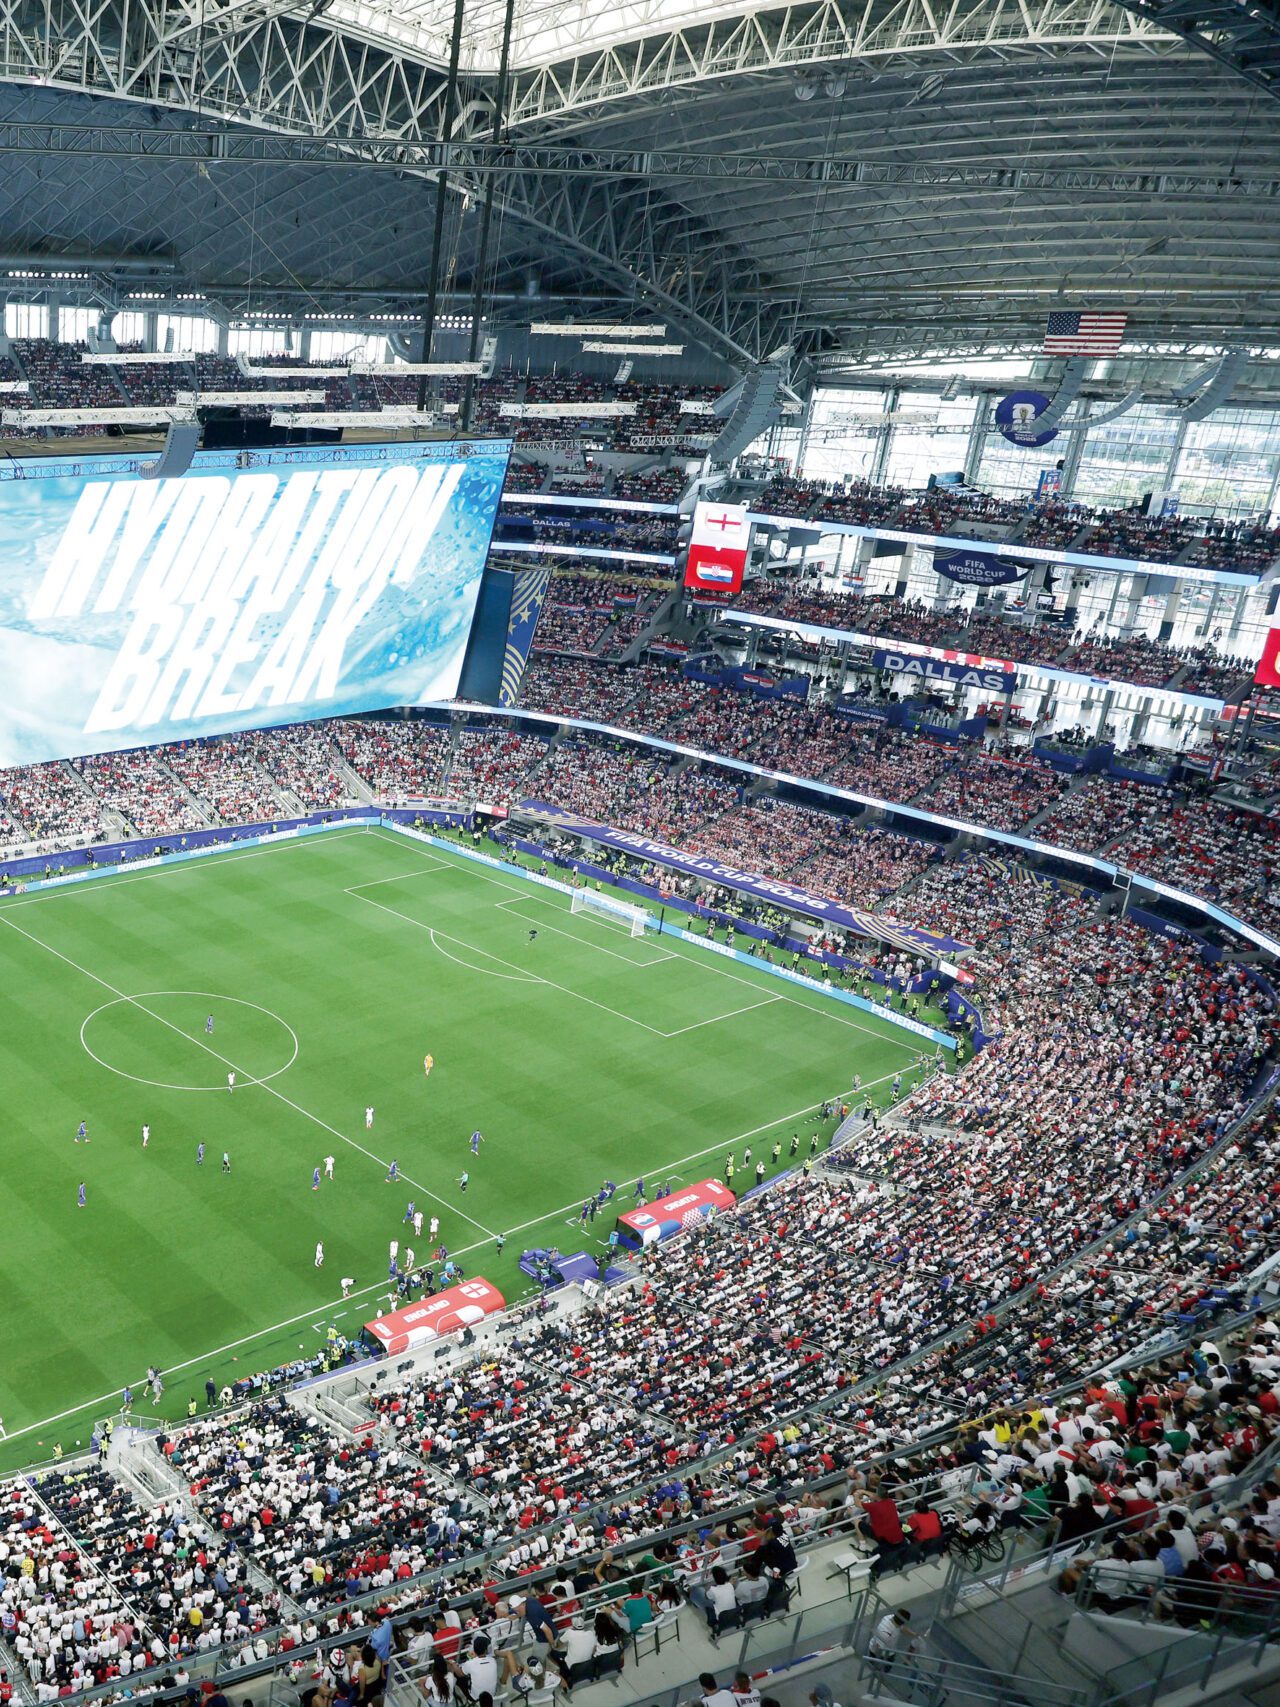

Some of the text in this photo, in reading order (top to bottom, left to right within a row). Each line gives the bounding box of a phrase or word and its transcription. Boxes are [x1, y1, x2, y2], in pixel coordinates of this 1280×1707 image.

[532, 519, 570, 527] DALLAS
[26, 464, 466, 620] HYDRATION
[875, 529, 937, 546] POWERADE
[998, 544, 1067, 562] POWERADE
[948, 564, 1006, 578] WORLD CUP
[965, 559, 986, 570] FIFA
[1138, 561, 1217, 582] POWERADE
[958, 573, 994, 583] 2026
[83, 578, 384, 733] BREAK
[923, 646, 932, 655] 3
[884, 655, 1004, 691] DALLAS
[541, 849, 554, 859] FIFA
[1035, 843, 1096, 866] POWERADE
[117, 857, 162, 873] POWERADE
[605, 831, 830, 911] FIFA WORLD CUP 2026
[1155, 883, 1208, 911] POWERADE
[681, 929, 737, 958] POWERADE
[772, 965, 833, 993] POWERADE
[871, 1003, 935, 1040] POWERADE
[663, 1193, 700, 1212] CROATIA
[402, 1299, 451, 1323] ENGLAND
